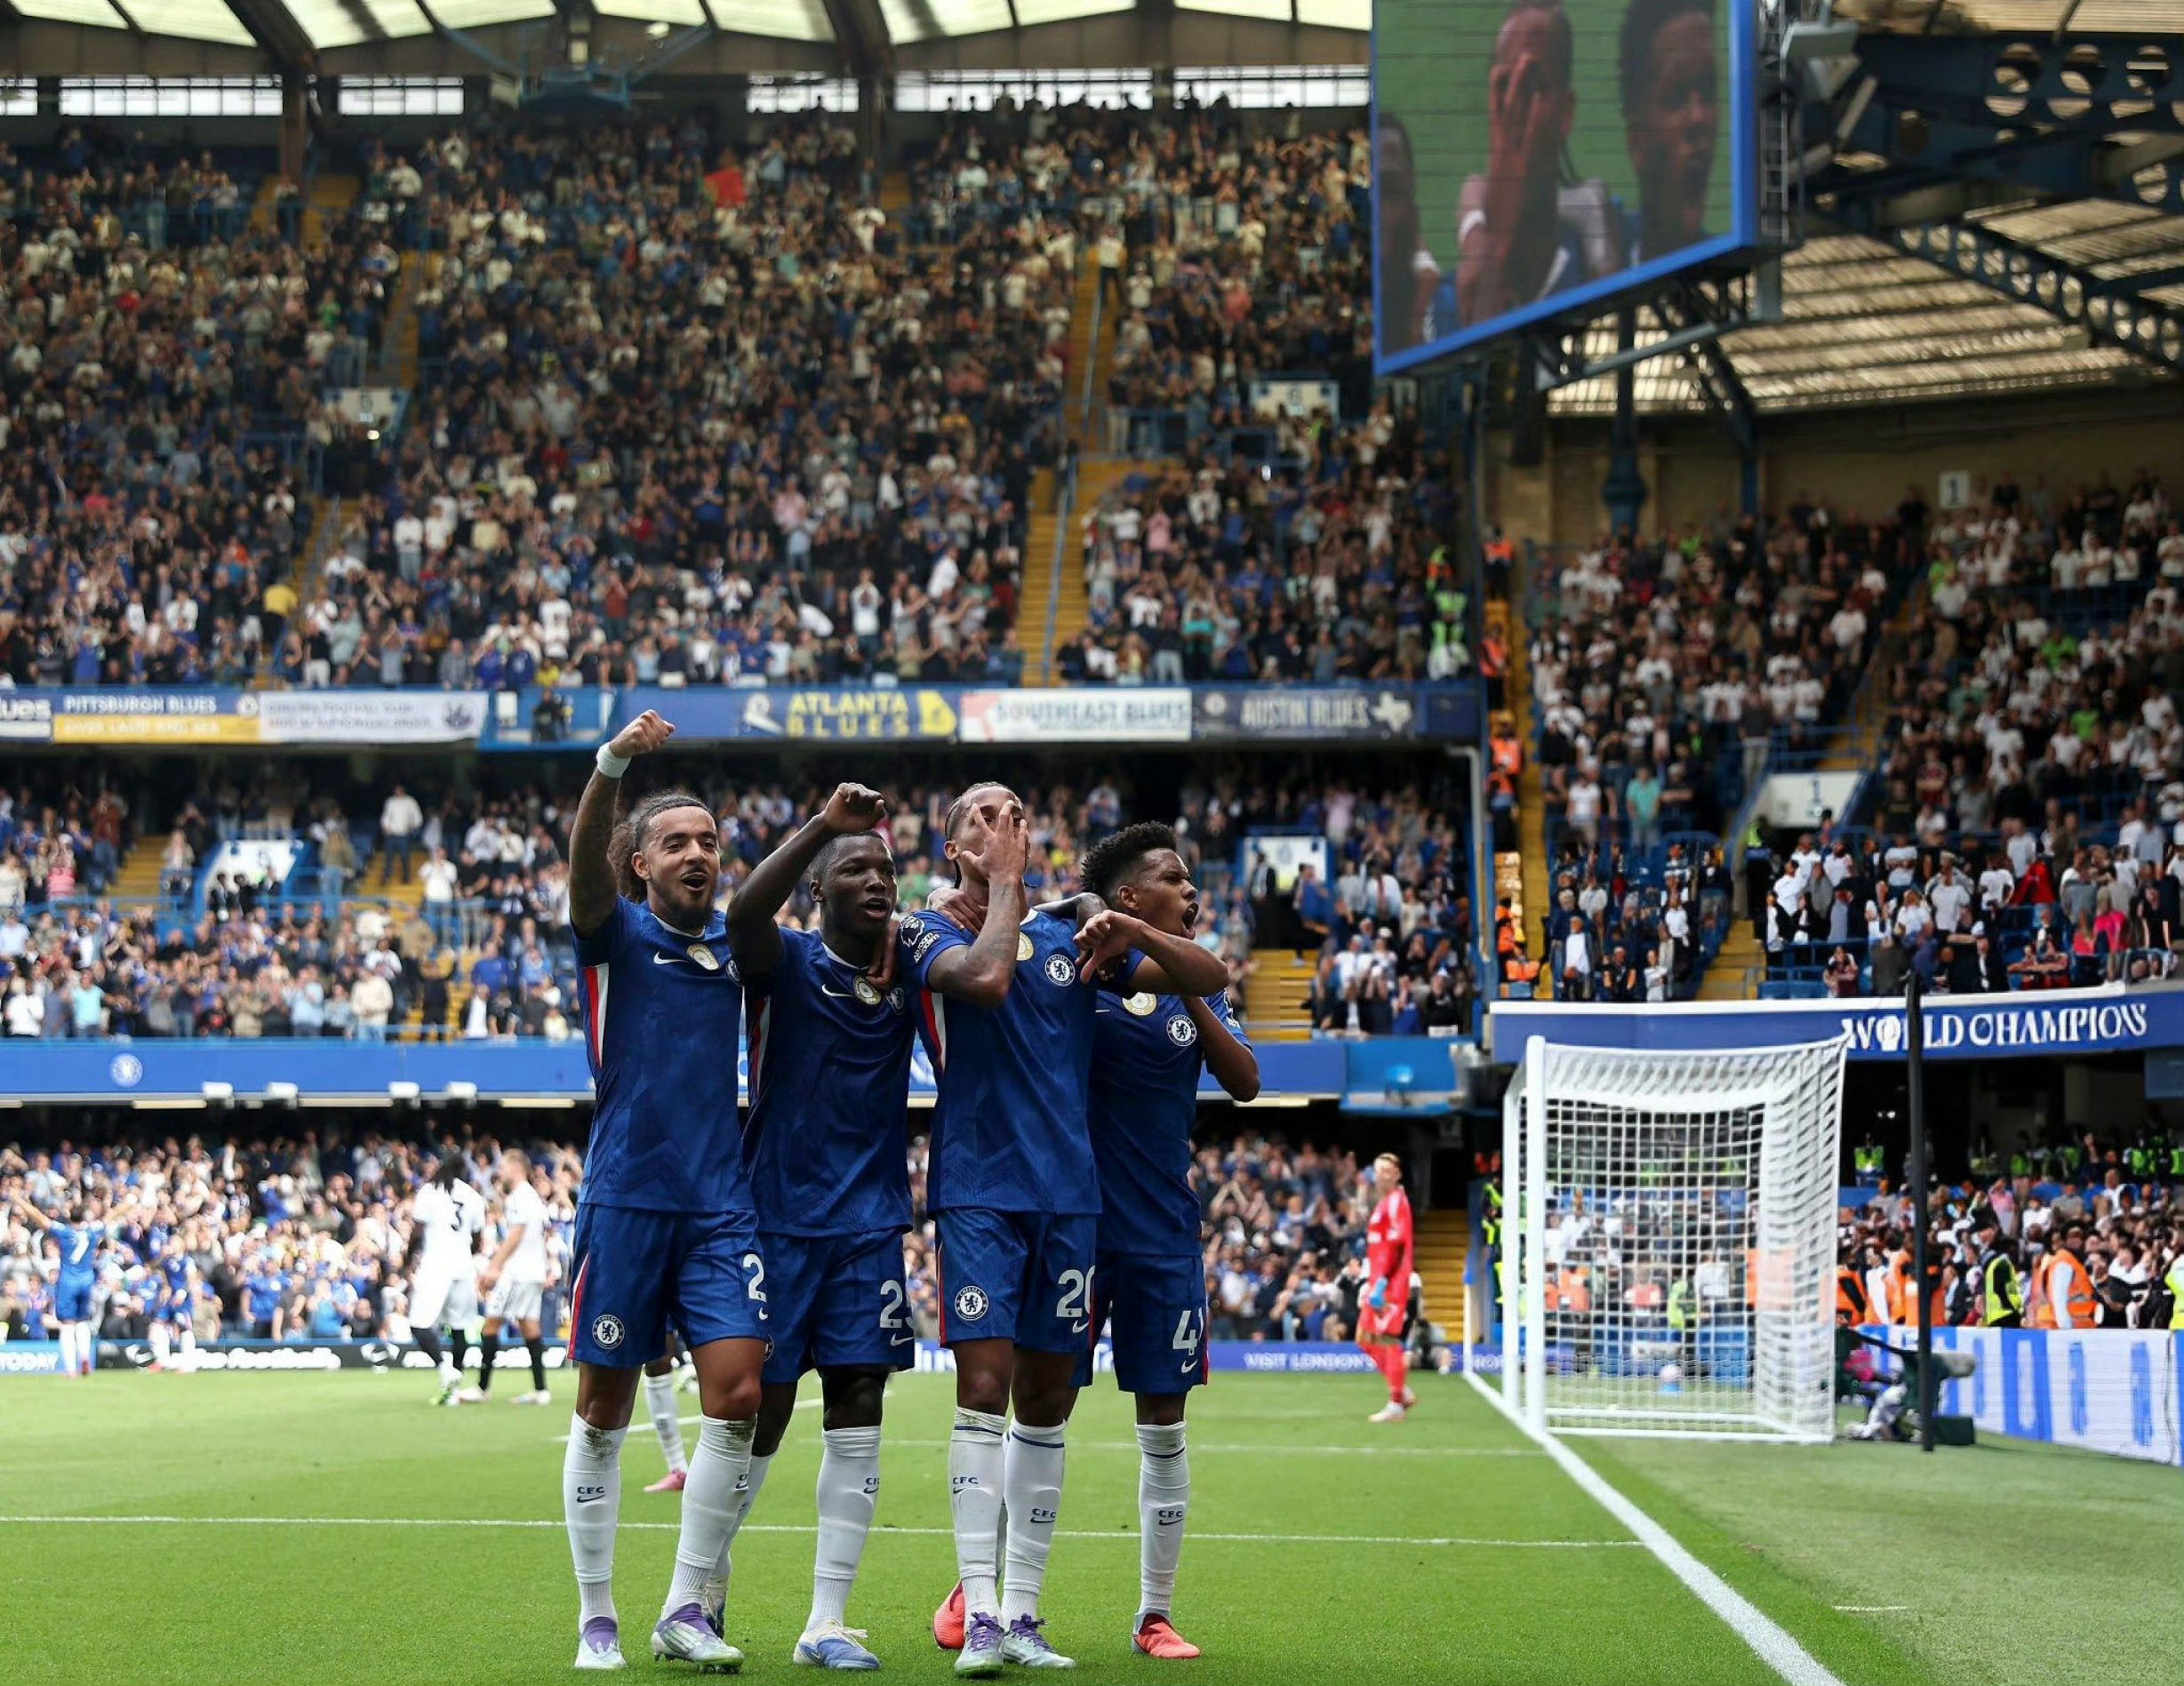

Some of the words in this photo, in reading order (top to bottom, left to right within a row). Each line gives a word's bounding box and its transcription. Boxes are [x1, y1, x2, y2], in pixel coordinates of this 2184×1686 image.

[63, 695, 164, 714] PITTSBURGH
[166, 695, 218, 714] BLUES
[788, 691, 908, 715] ATLANTA
[1125, 700, 1185, 723] BLUES
[1240, 697, 1308, 727] AUSTIN
[1309, 695, 1370, 729] BLUES
[787, 714, 909, 738] BLUES
[1841, 1014, 1964, 1052] WOLD
[1969, 1003, 2148, 1047] CHAMPIONS
[451, 1200, 464, 1232] 3
[71, 1230, 89, 1265] 7
[880, 1279, 916, 1329] 2
[1243, 1352, 1287, 1370] VISIT
[577, 1486, 605, 1495] CFC
[1031, 1507, 1057, 1519] CFC
[1158, 1509, 1183, 1518] CFC
